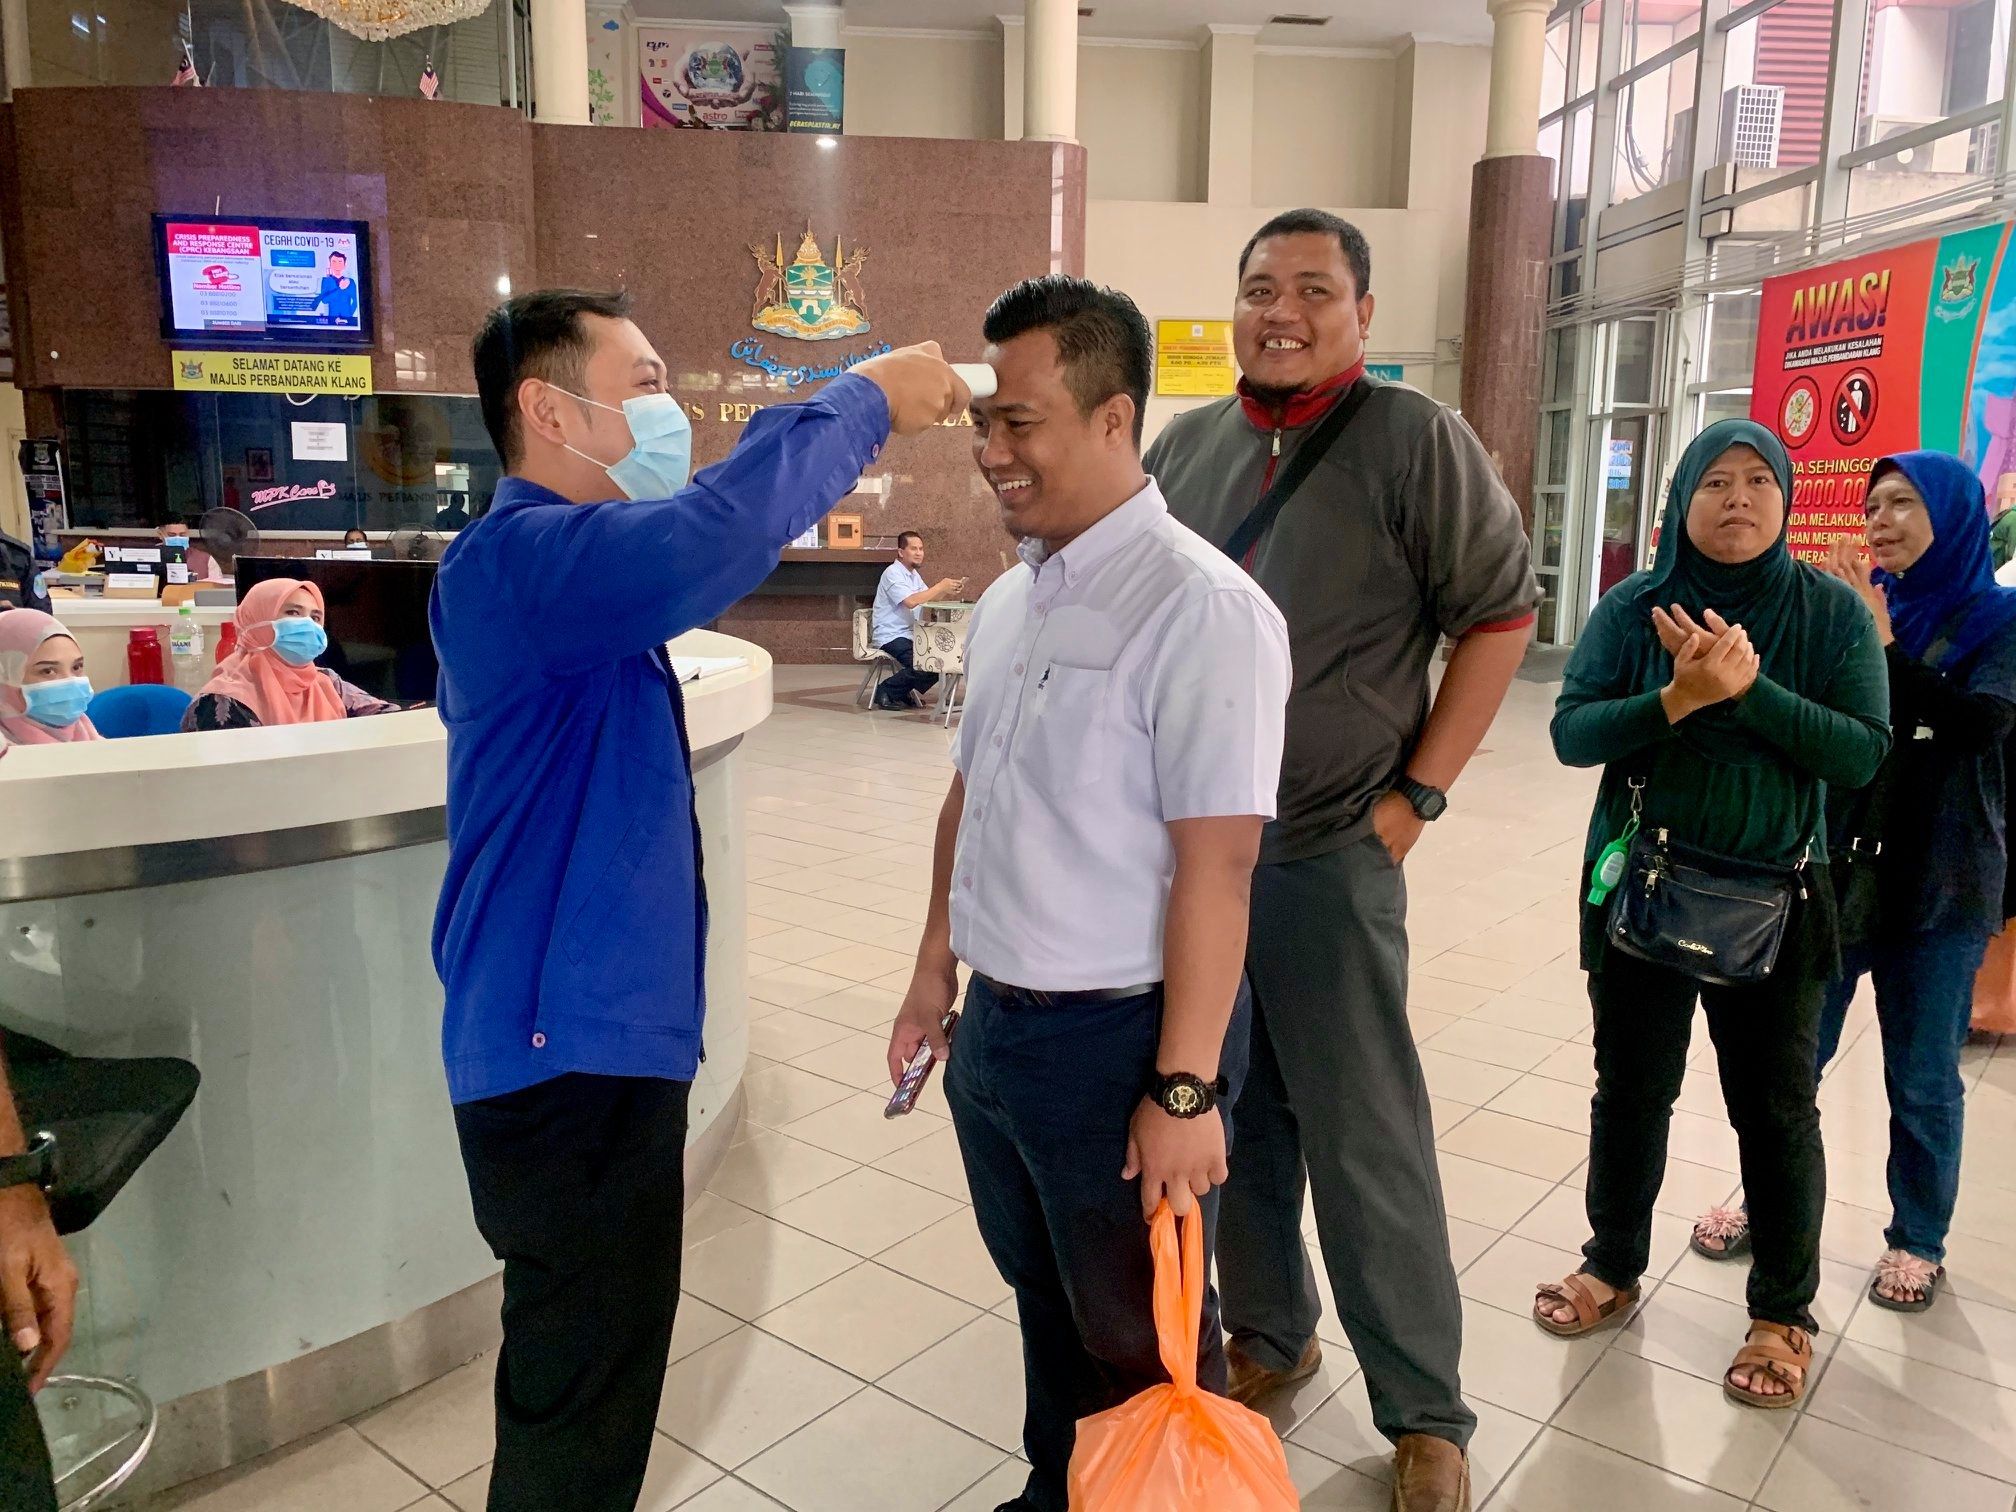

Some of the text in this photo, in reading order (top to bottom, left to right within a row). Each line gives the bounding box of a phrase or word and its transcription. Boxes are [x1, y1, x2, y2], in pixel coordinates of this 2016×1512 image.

[702, 111, 728, 120] astro
[174, 233, 251, 243] CRISIS PREPAREDNESS
[264, 235, 292, 246] CEGAH
[190, 241, 226, 249] RESPONSE
[203, 247, 250, 255] KEBANGSAAN
[1786, 269, 1892, 343] AWAS!
[1798, 348, 1812, 358] ANDA
[1813, 343, 1847, 356] MELAKUKAN
[1847, 337, 1883, 350] KESALAHAN
[1828, 350, 1863, 363] PERBANDARAN
[232, 357, 342, 373] SELAMAT DATANG KE
[210, 373, 366, 389] MAJLIS PERBANDARAN KLANG
[251, 485, 290, 504] MPK
